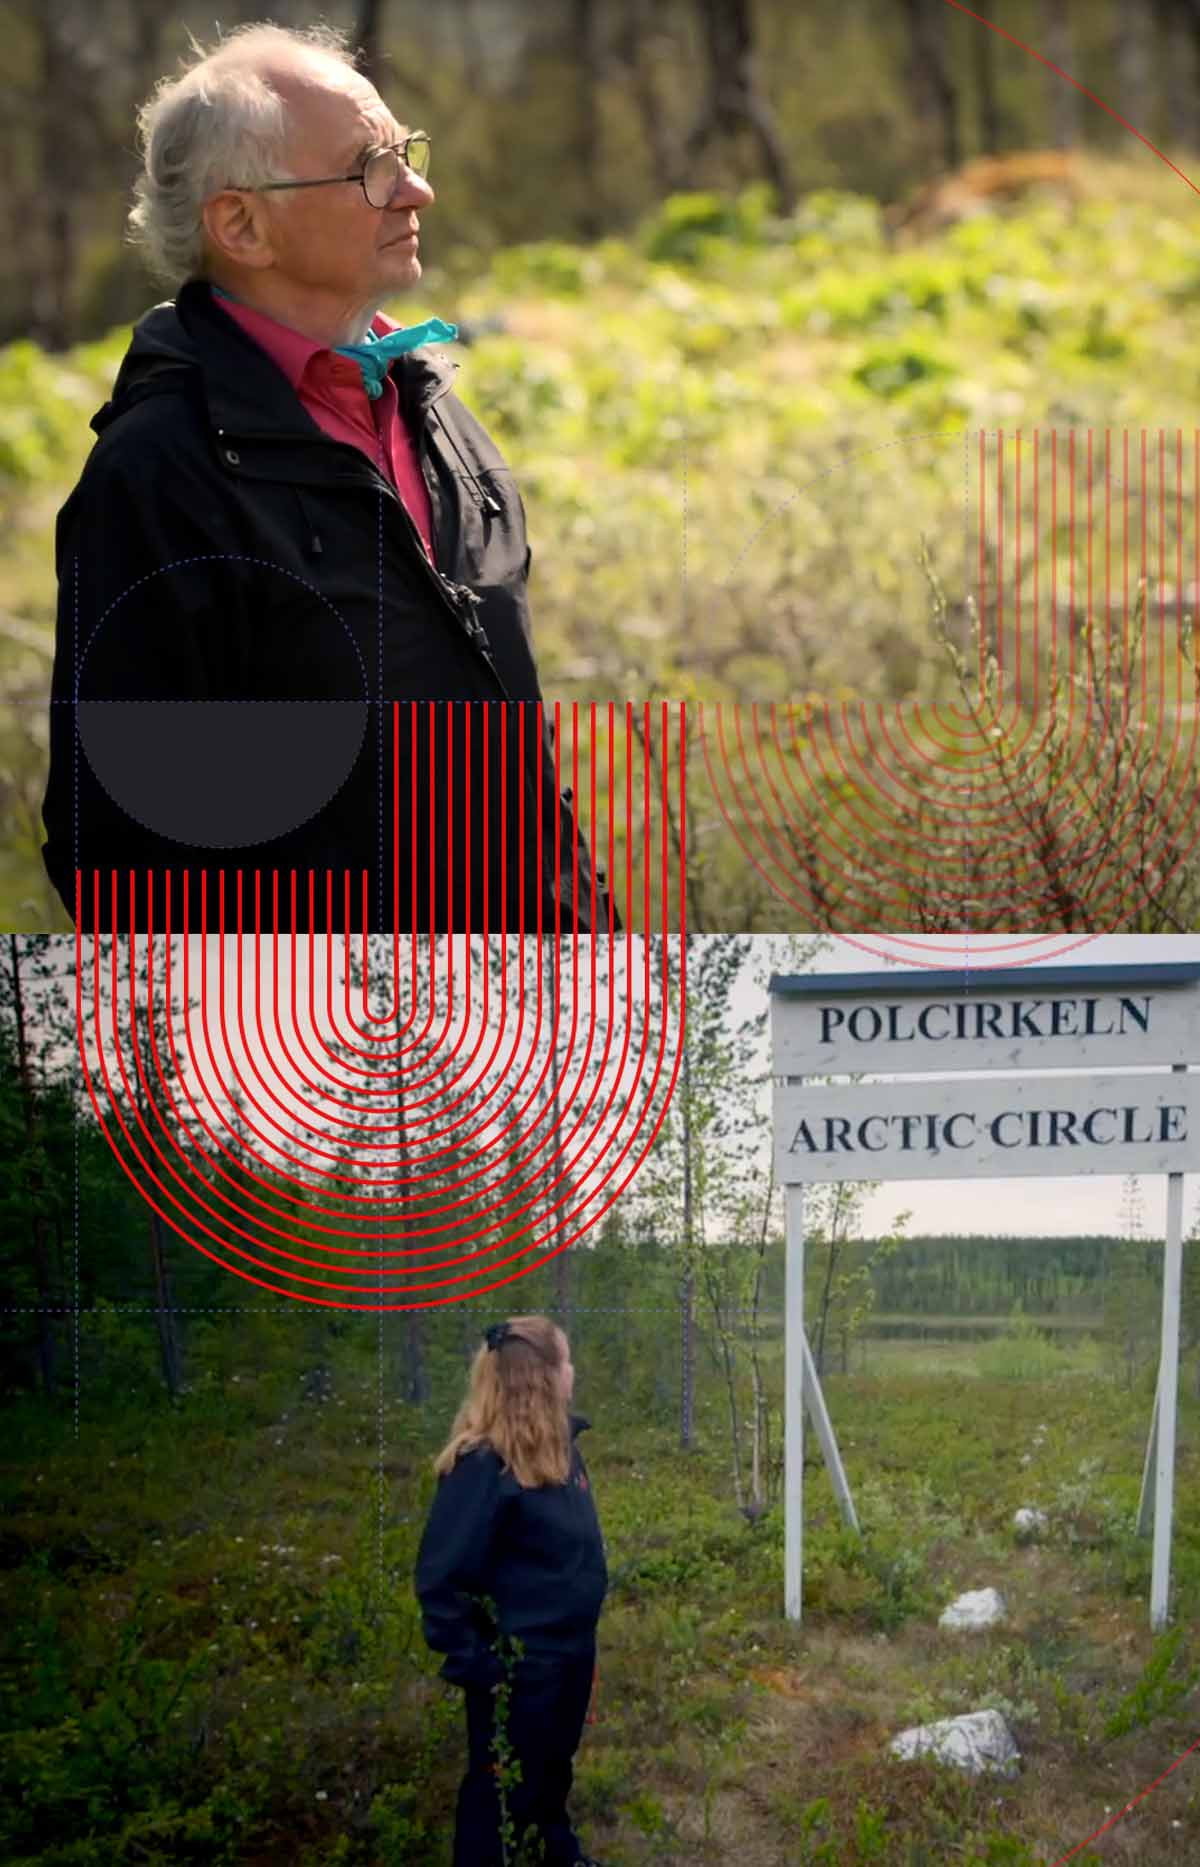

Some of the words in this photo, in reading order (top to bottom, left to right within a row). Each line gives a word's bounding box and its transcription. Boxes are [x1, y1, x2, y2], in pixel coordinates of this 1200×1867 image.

[818, 996, 1153, 1044] POLCIRKELN
[788, 1112, 977, 1156] ARCTIC
[989, 1105, 1188, 1149] CIRCLE
